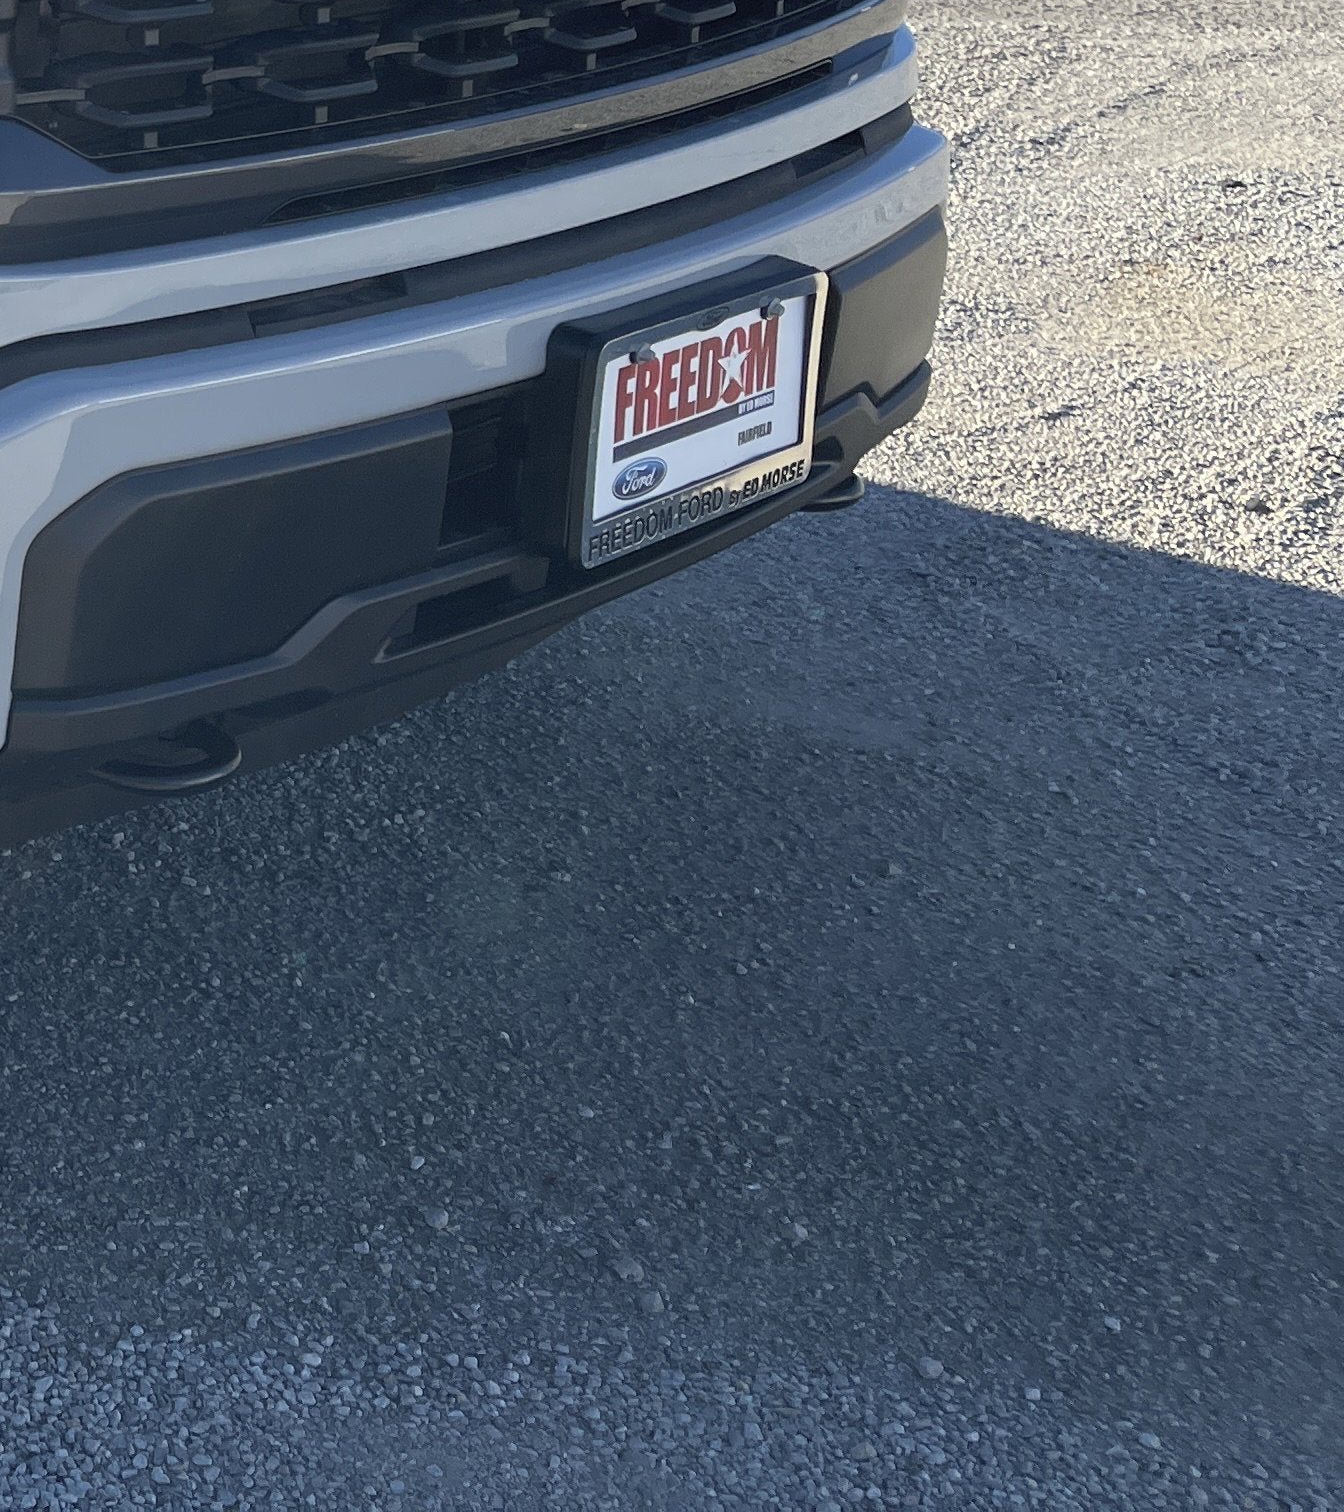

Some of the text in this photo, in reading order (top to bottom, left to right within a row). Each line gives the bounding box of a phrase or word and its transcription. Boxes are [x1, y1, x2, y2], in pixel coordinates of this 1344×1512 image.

[614, 317, 779, 444] FREEDOM
[738, 421, 772, 446] FAIRFIELD
[588, 506, 673, 562] FREEDOM
[678, 487, 723, 525] FORD
[743, 477, 759, 499] ED
[761, 459, 805, 493] MORSE
[622, 465, 656, 495] Ford
